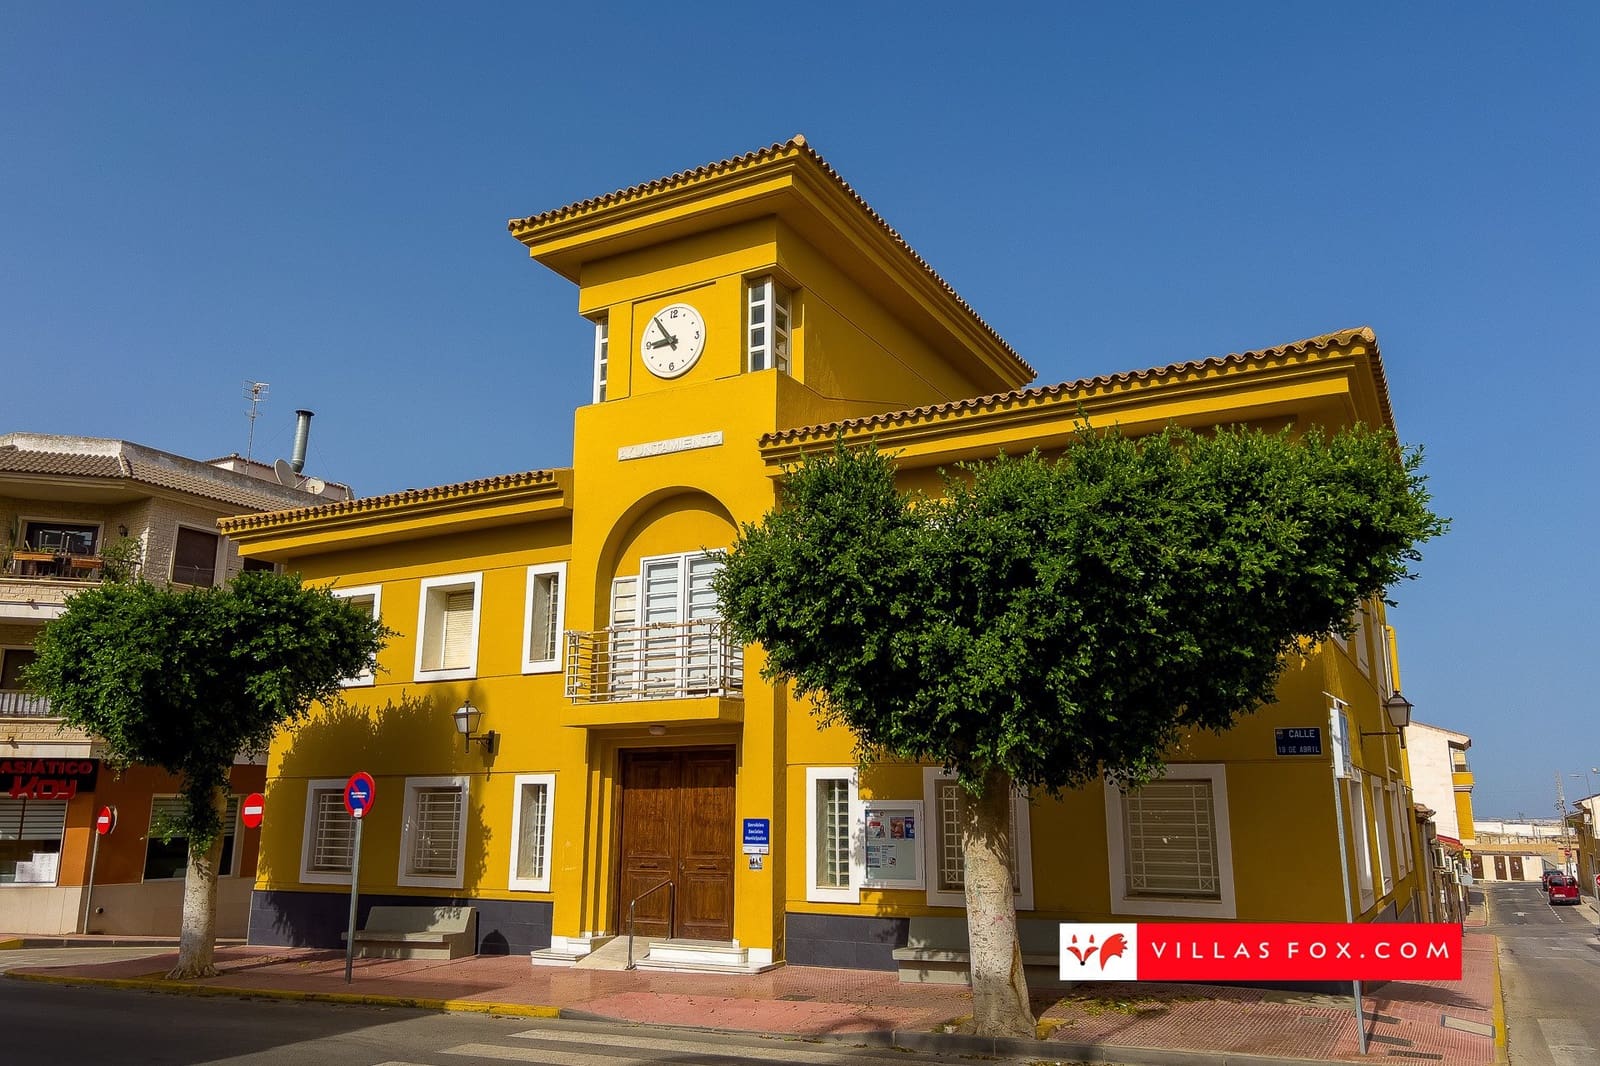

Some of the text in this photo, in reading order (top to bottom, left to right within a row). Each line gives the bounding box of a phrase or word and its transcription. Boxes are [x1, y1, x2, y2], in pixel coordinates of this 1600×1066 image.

[670, 309, 679, 319] 12
[694, 330, 700, 340] 3
[645, 341, 652, 350] 9
[668, 362, 675, 371] 6
[1288, 729, 1316, 738] CALLE
[1288, 745, 1297, 753] DE
[1299, 745, 1320, 753] ABRIL
[0, 759, 93, 775] ASIÁTICO
